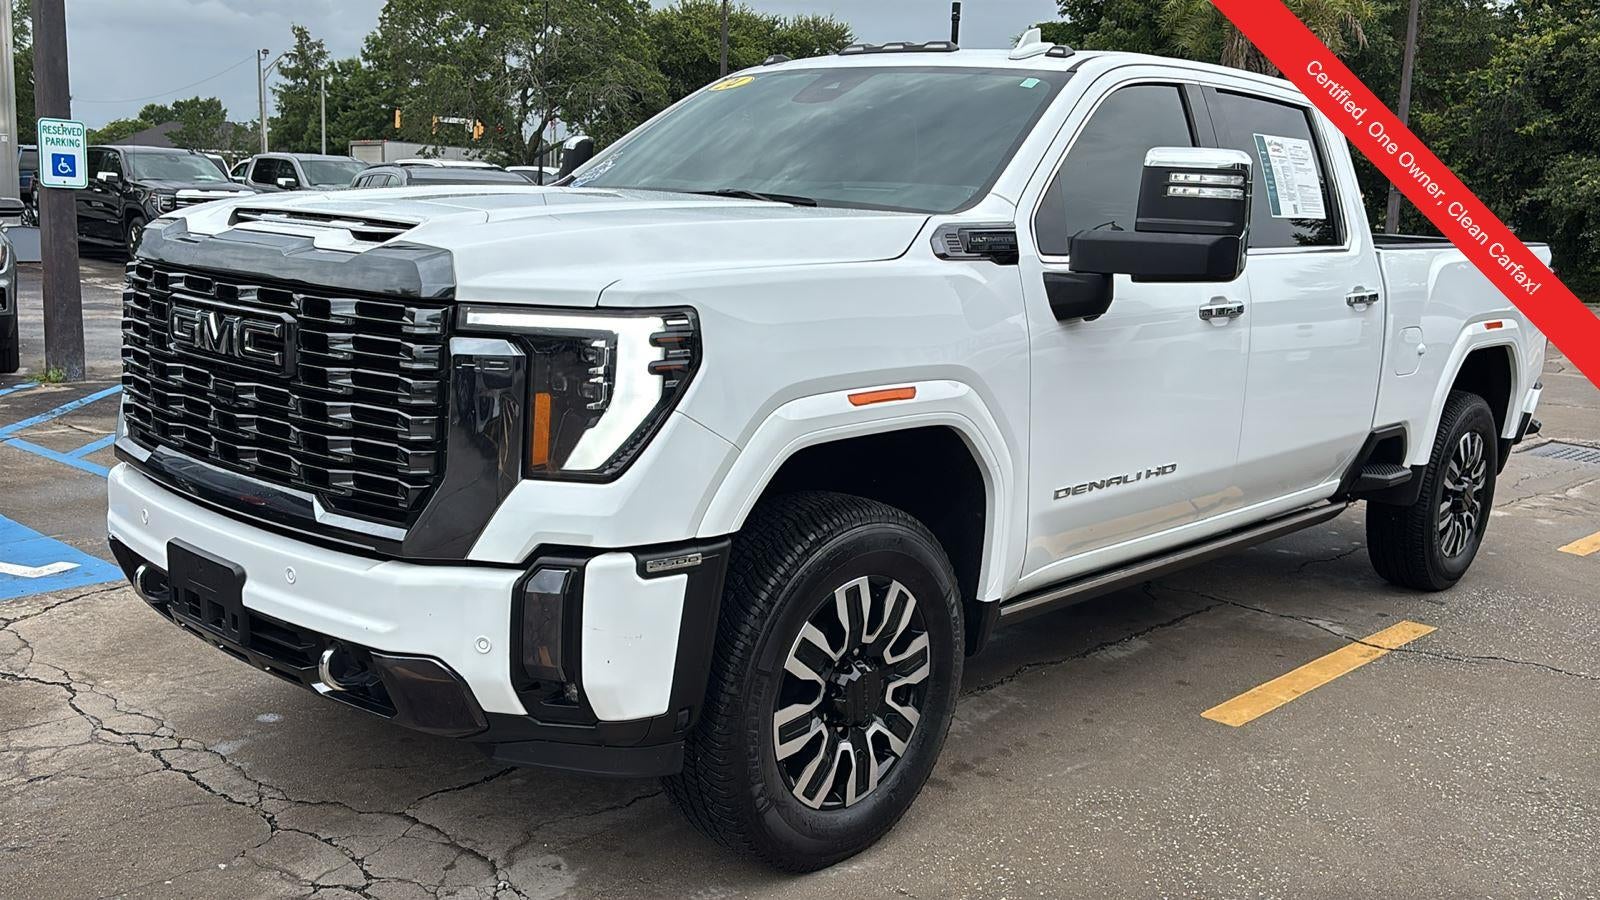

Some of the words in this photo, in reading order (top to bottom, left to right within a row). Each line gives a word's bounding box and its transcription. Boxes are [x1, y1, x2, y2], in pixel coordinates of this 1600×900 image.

[42, 125, 83, 137] RESERVED
[45, 136, 81, 148] PARKING
[168, 307, 282, 366] GMC
[1053, 471, 1142, 500] DENALI
[1145, 463, 1178, 480] HD
